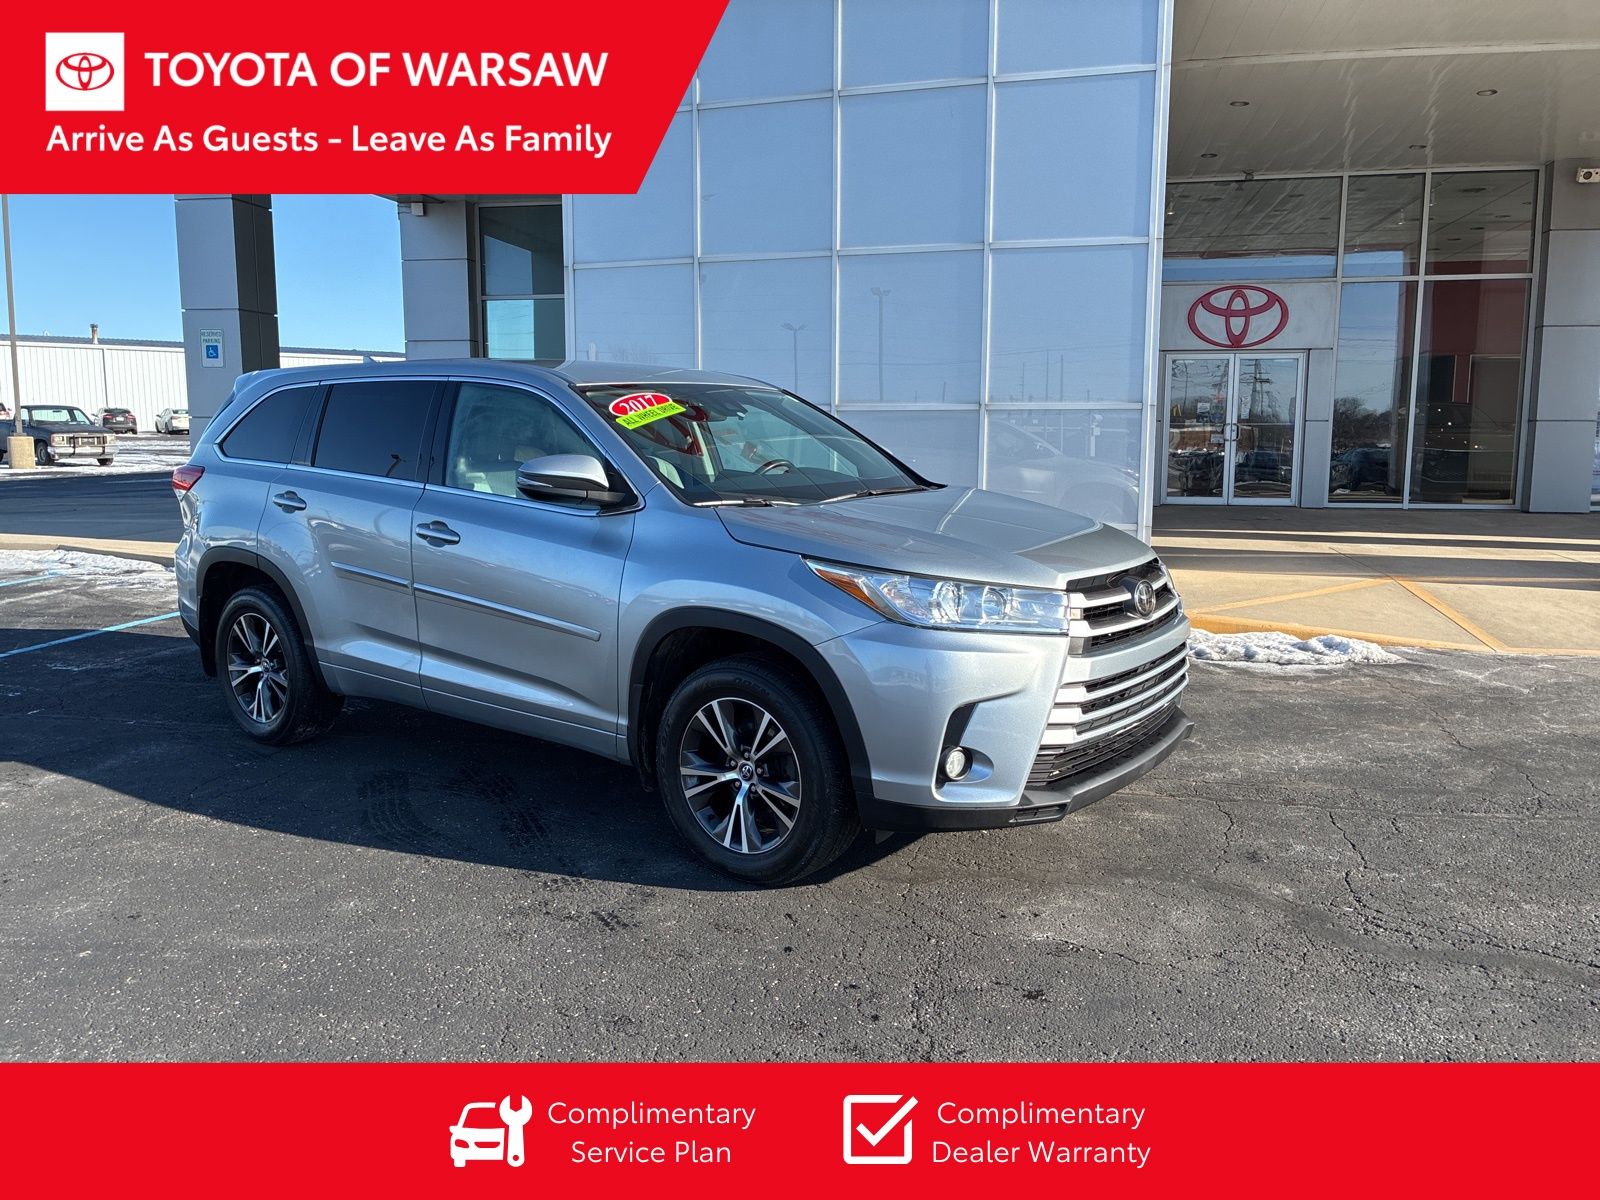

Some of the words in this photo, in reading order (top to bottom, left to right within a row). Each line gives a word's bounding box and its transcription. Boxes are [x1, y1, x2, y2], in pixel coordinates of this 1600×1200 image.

[619, 394, 657, 415] 2017
[637, 408, 661, 421] WHEEL
[656, 403, 679, 413] DRIVE
